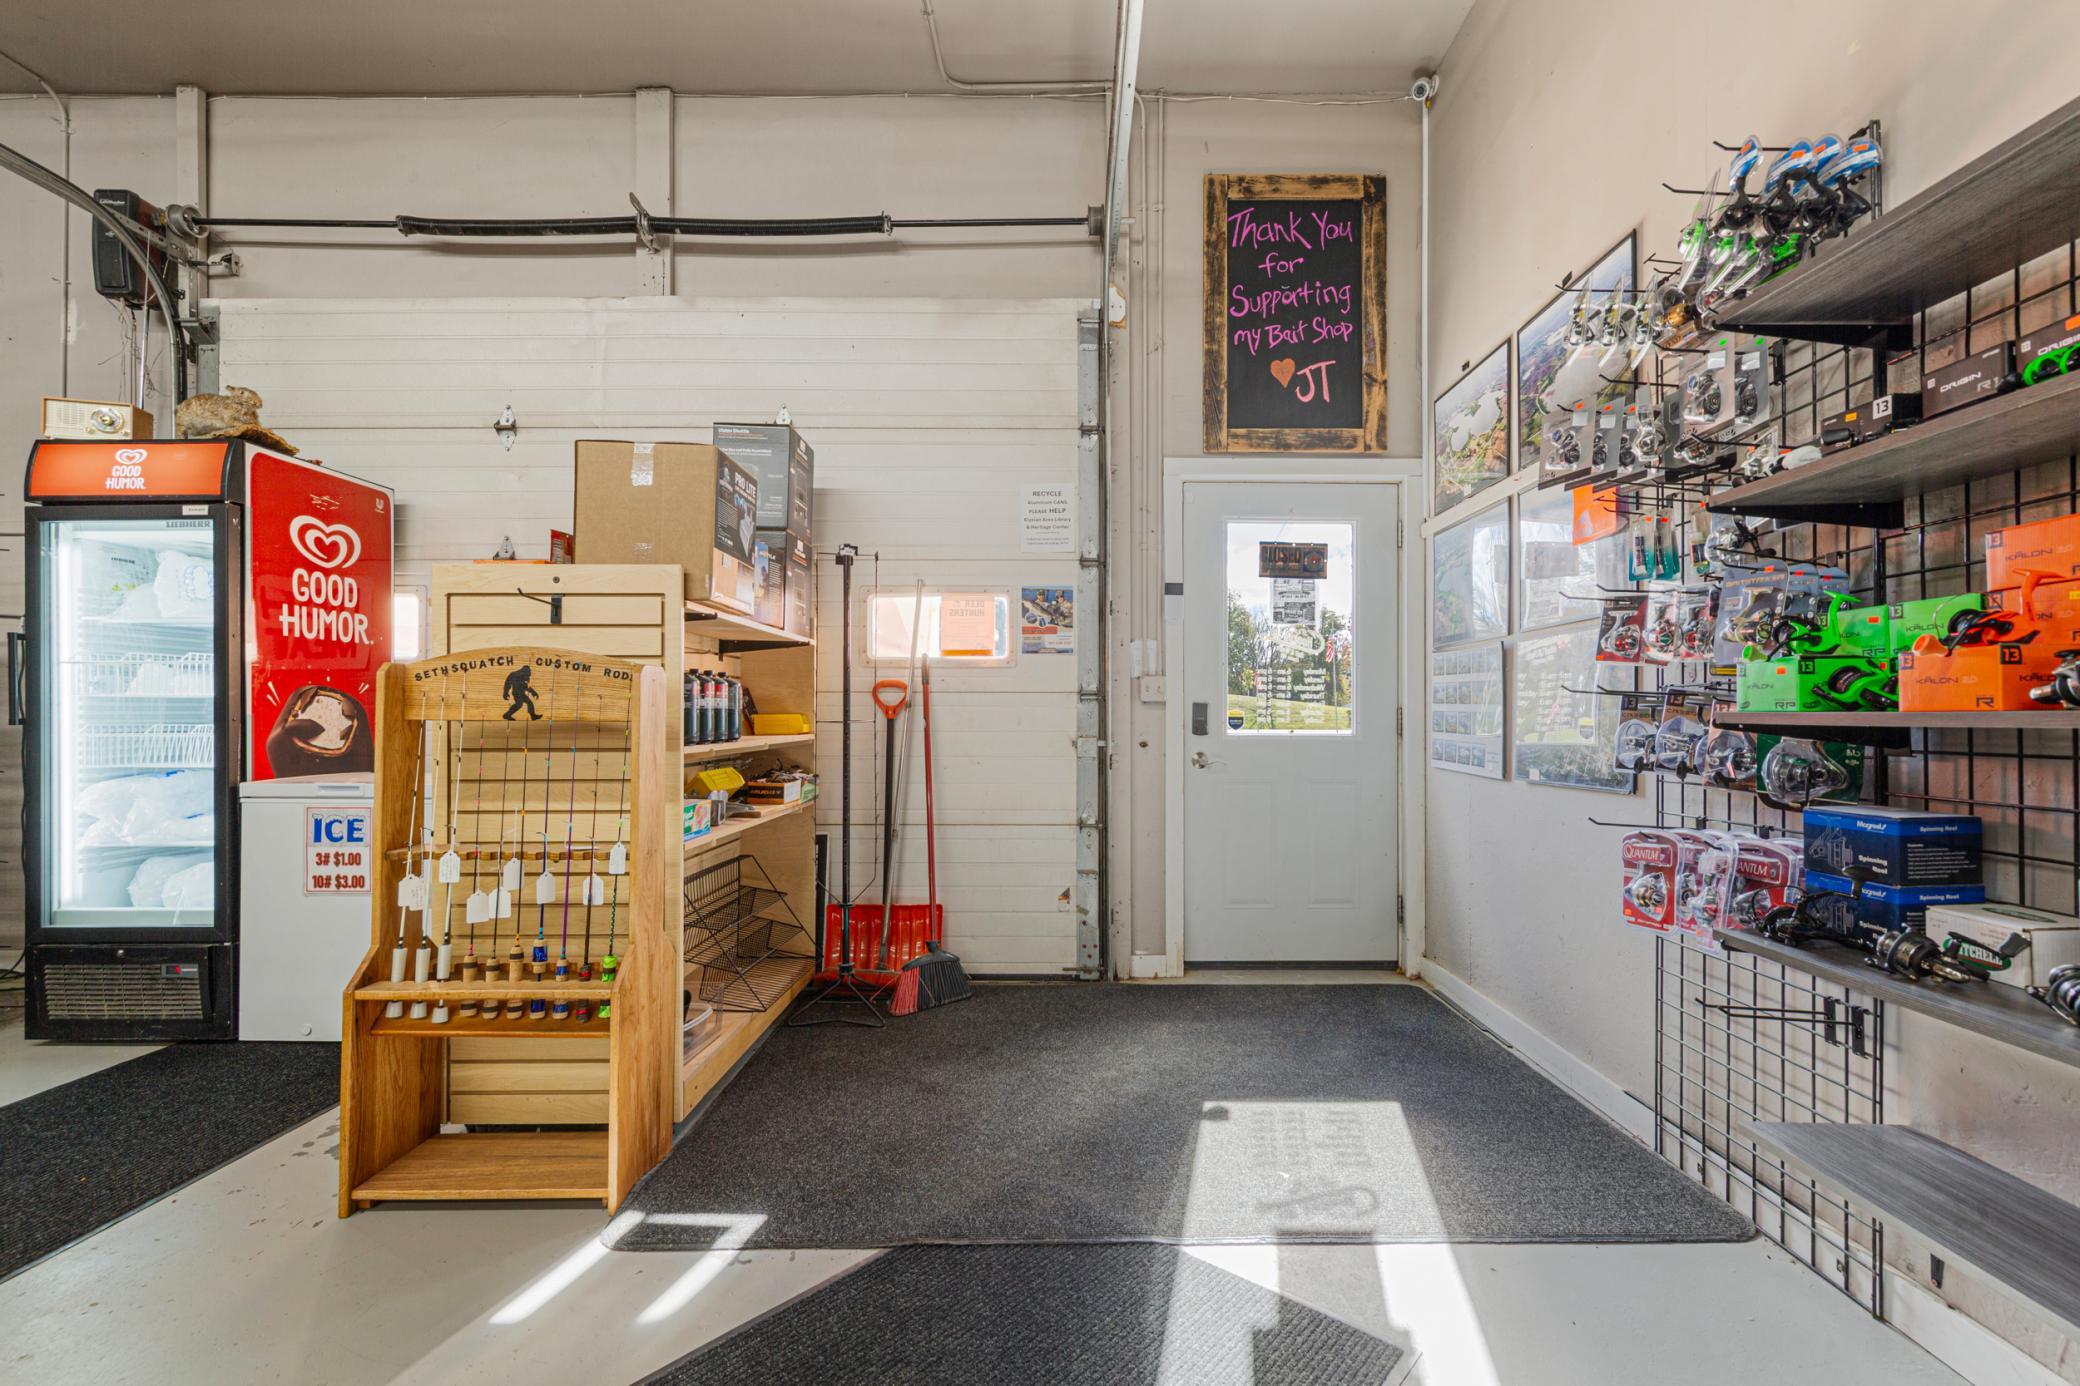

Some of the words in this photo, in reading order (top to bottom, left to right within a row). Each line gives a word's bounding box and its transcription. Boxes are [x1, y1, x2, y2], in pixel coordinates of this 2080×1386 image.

[1227, 207, 1313, 250] Thank
[1311, 210, 1353, 250] You
[1258, 252, 1304, 278] for
[1229, 281, 1352, 319] Supporting
[1233, 327, 1261, 356] my
[1264, 320, 1309, 349] Bait
[1311, 316, 1353, 344] Shop
[1295, 360, 1336, 403] JT
[1940, 371, 1982, 393] ORIGIN
[1875, 400, 1889, 414] 13
[112, 465, 141, 477] GOOD
[105, 477, 145, 489] HUMOR
[291, 567, 358, 609] GOOD
[279, 603, 369, 645] HUMOR
[2003, 649, 2020, 662] 13
[414, 655, 514, 682] SETHSQUATCH
[535, 657, 592, 673] CUSTOM
[1800, 660, 1814, 672] 13
[1775, 700, 1796, 709] RP
[312, 814, 365, 843] ICE
[315, 852, 330, 866] 3#
[333, 851, 362, 867] $1.00
[1623, 844, 1661, 863] QUANTUM
[1858, 855, 1888, 866] Spinning
[1737, 861, 1768, 877] ANTUM
[312, 875, 332, 888] 10#
[335, 873, 365, 890] $3.00
[1859, 920, 1888, 934] Spinning
[1956, 941, 2003, 965] ITCHELL
